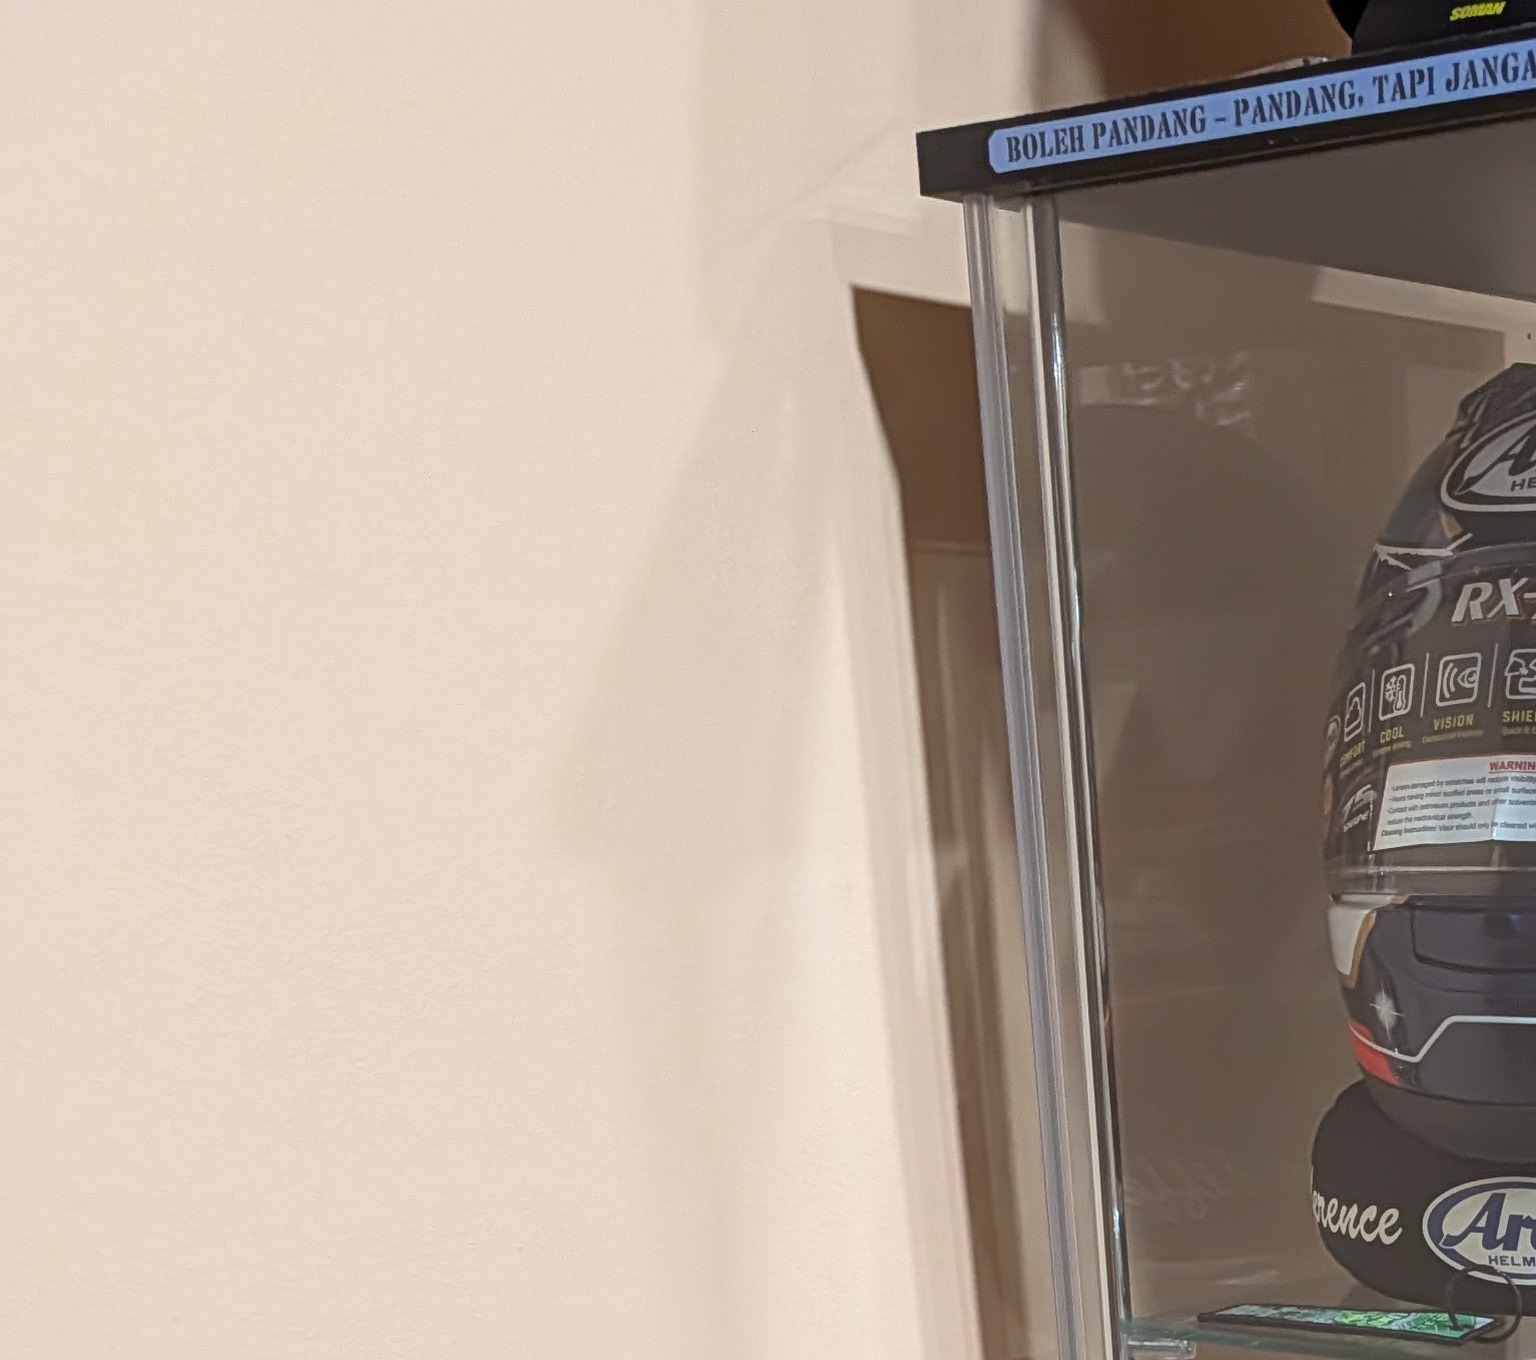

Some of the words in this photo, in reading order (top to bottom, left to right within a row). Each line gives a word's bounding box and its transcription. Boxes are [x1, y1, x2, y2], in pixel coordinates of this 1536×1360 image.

[1007, 125, 1085, 163] BOLEH
[1093, 105, 1206, 150] PANDANG
[1234, 80, 1365, 128] PANDANG,
[1373, 66, 1435, 106] TAPI
[1433, 713, 1475, 731] VISION
[1380, 727, 1404, 744] COOL
